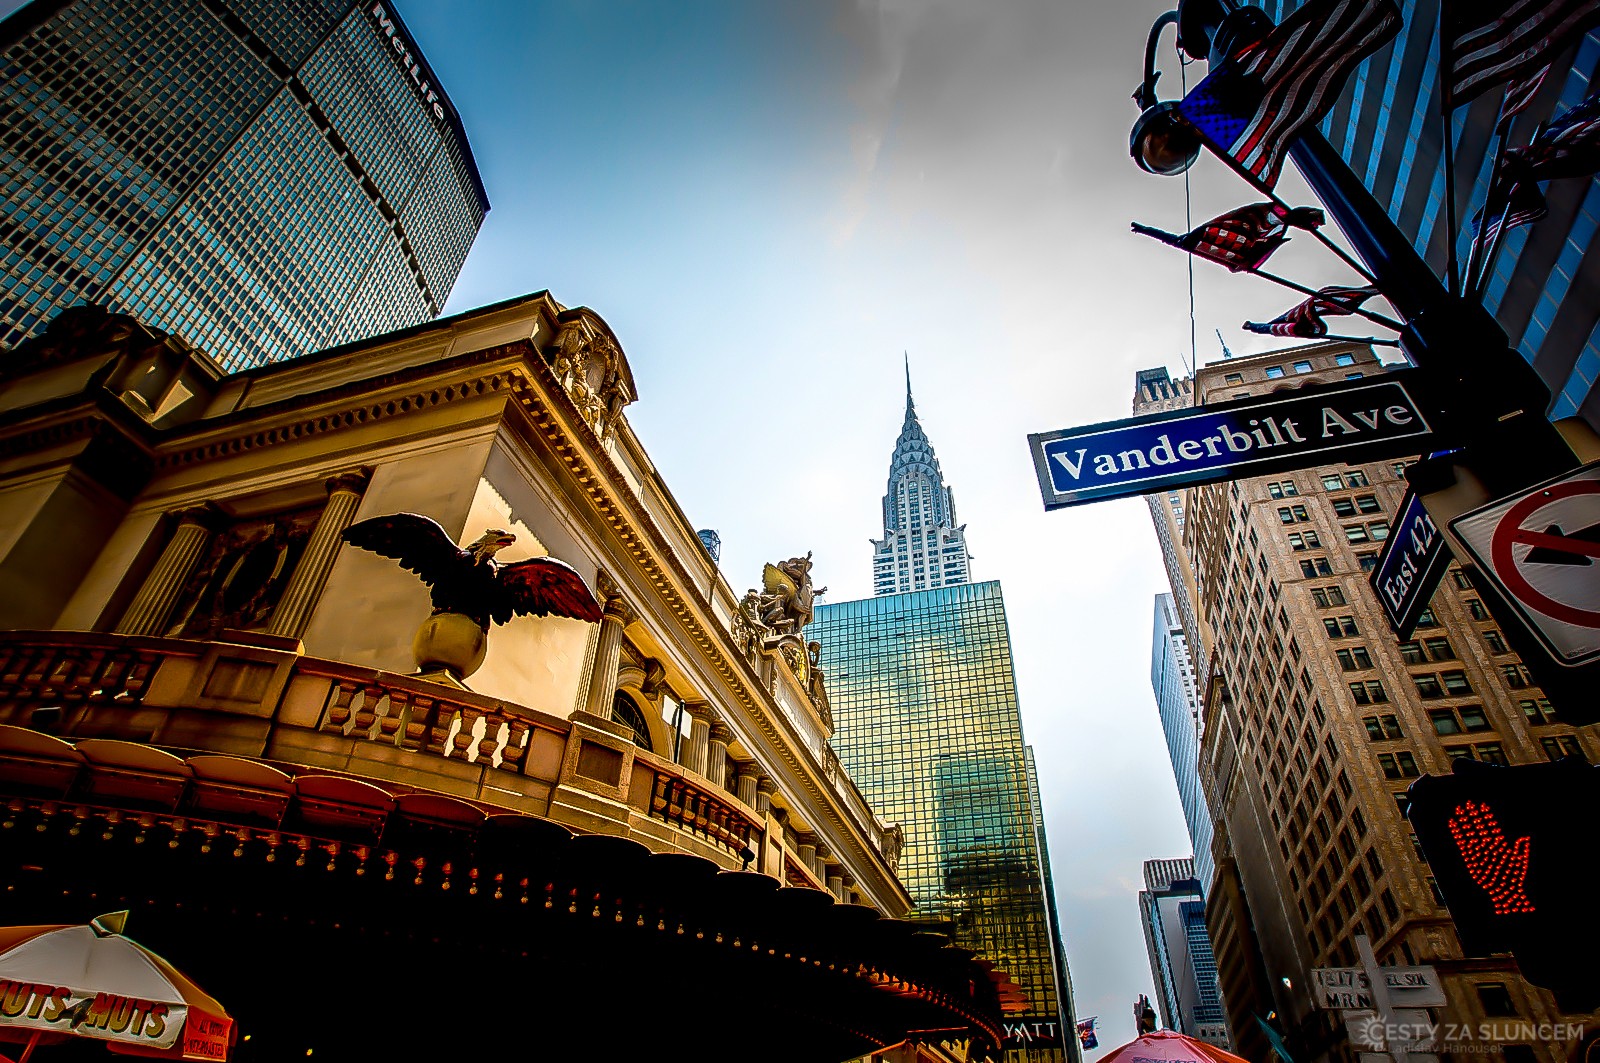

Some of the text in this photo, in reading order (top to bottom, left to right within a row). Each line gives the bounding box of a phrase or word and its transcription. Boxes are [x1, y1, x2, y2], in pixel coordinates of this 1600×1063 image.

[373, 3, 444, 119] MetLife
[1052, 405, 1413, 480] Vanderbilt Ave
[1384, 551, 1417, 611] East
[86, 992, 169, 1038] NUTS
[1003, 1022, 1057, 1042] YATT
